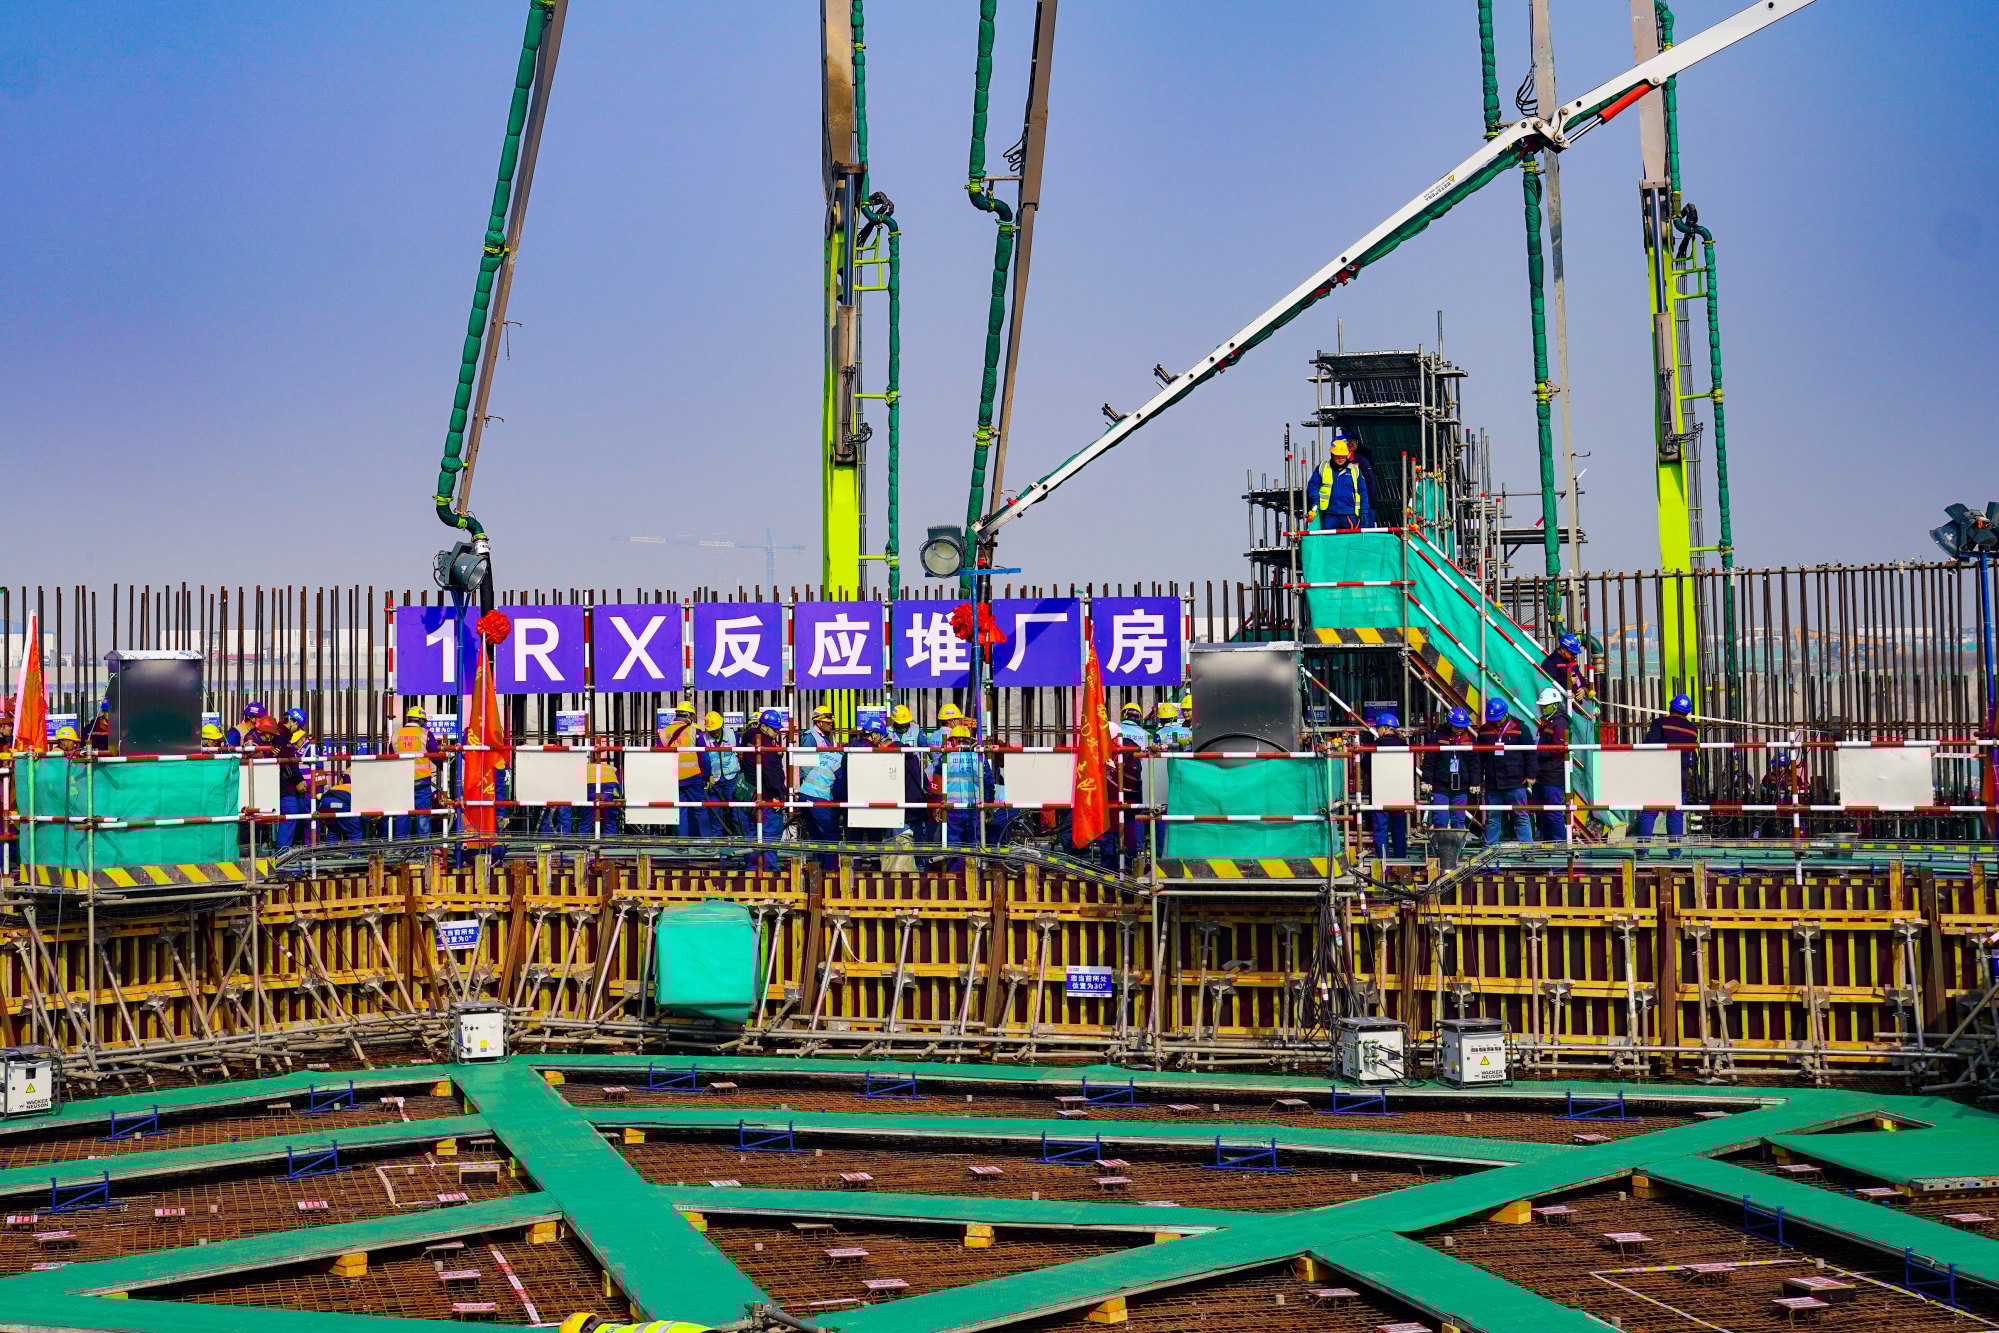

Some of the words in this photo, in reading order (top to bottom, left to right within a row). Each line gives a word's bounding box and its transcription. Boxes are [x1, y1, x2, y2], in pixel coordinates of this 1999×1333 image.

[1070, 974, 1108, 983] 您当前所处
